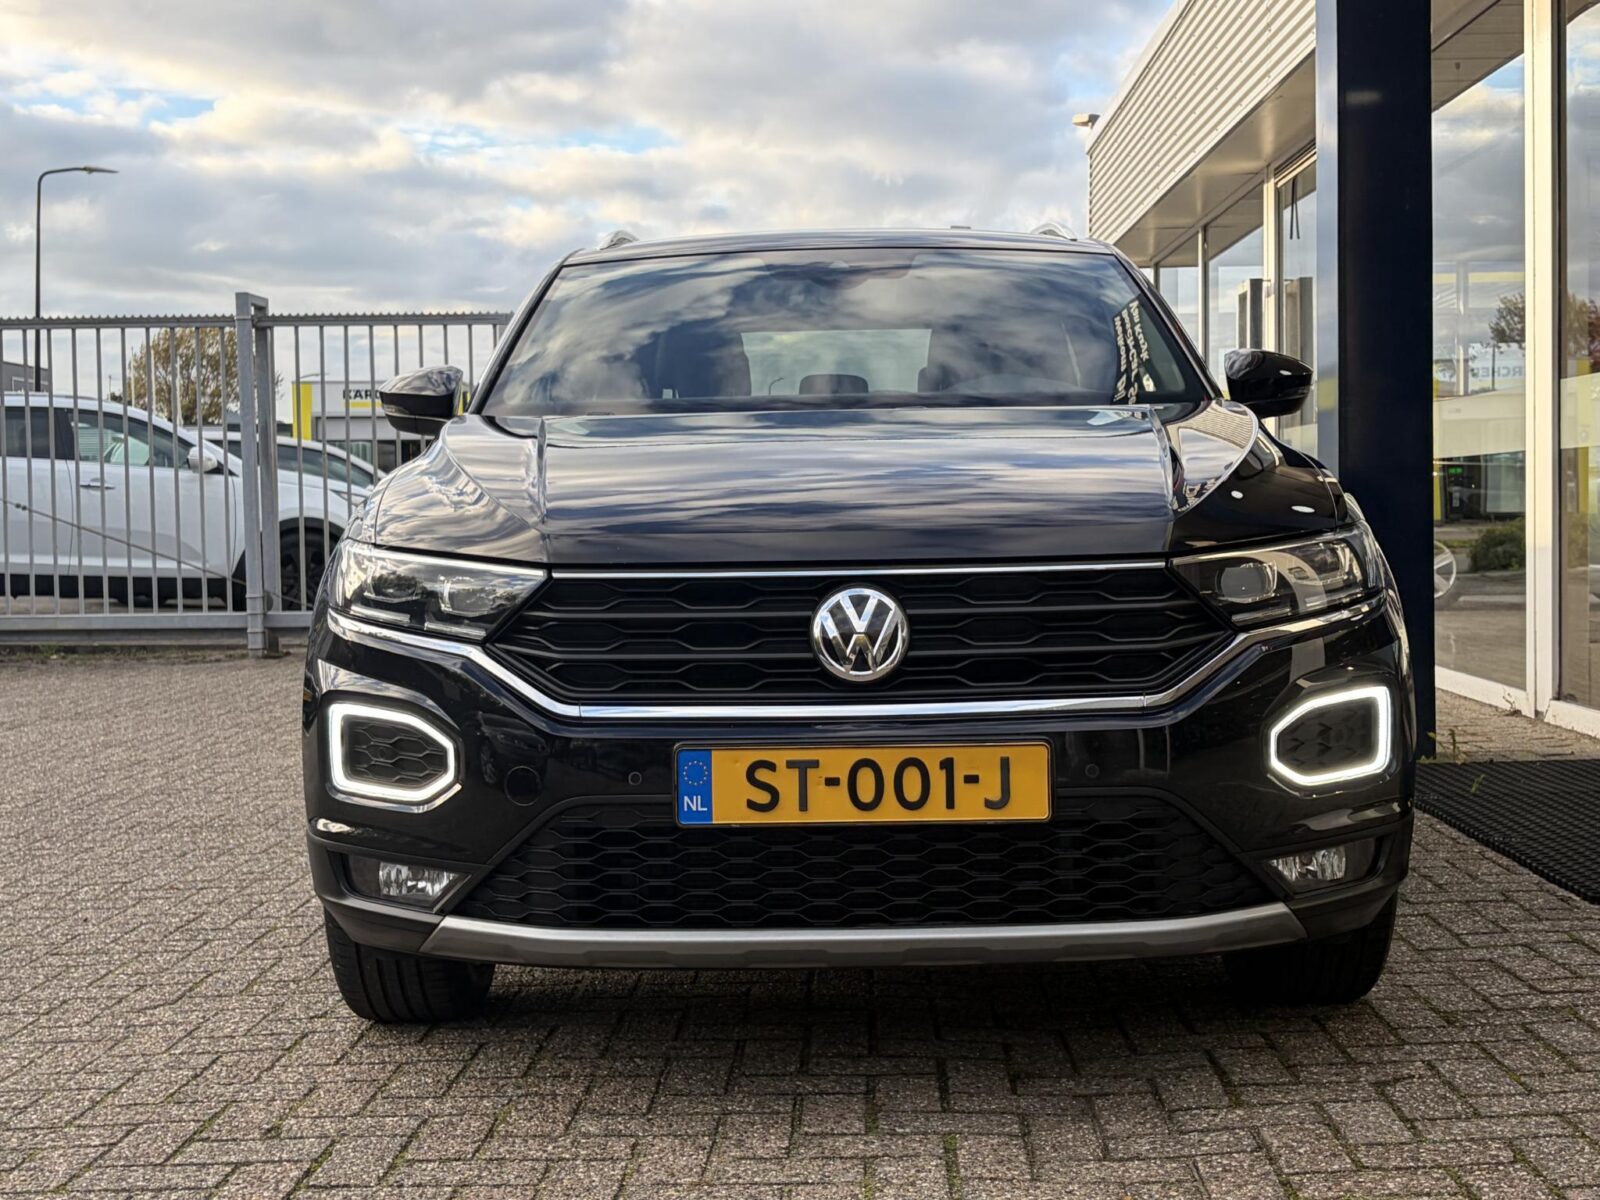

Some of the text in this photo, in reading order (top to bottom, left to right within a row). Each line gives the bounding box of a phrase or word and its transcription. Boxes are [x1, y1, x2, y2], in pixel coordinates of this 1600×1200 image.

[814, 588, 907, 682] VW
[684, 795, 708, 812] NL
[745, 757, 1011, 813] ST-001-J
